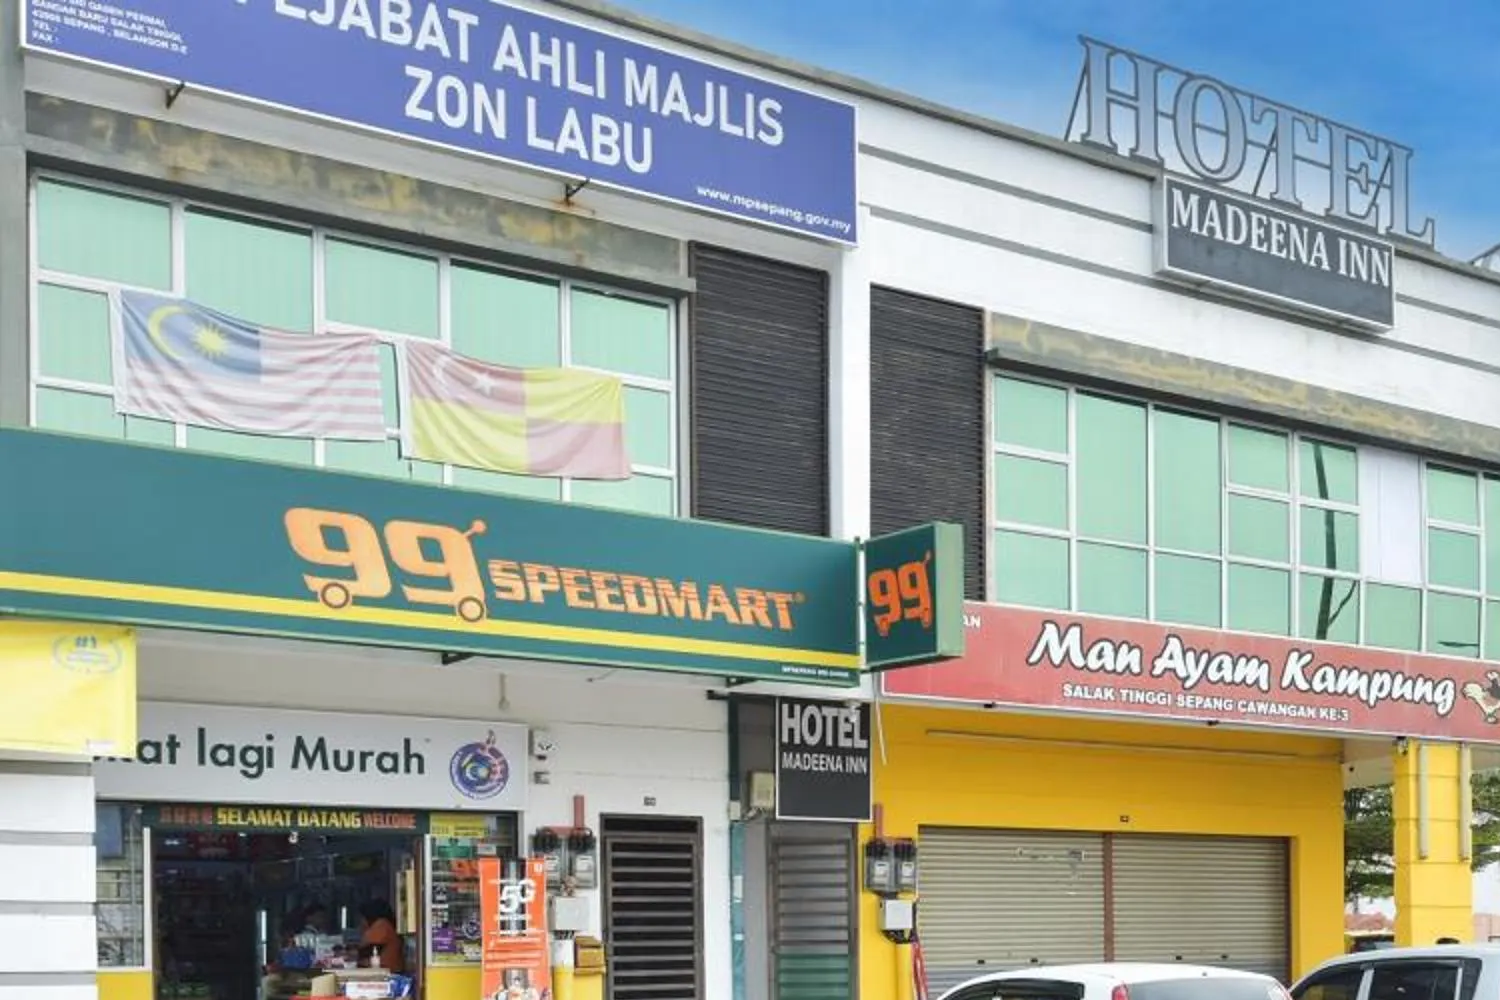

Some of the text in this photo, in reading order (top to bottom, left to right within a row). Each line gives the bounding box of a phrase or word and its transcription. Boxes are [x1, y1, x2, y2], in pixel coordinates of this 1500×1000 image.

[404, 65, 653, 173] ZON LABU
[492, 24, 606, 99] AHLI
[623, 57, 784, 147] MAJLIS
[1078, 33, 1435, 251] HOTEL
[697, 184, 852, 235] www.mpsepang.gov.my
[1171, 186, 1390, 287] MADEENA INN
[283, 506, 796, 631] 99 SPEEDMART
[867, 549, 932, 637] 99
[1027, 620, 1456, 716] Man Ayam Kampung
[1063, 683, 1115, 701] SALAK
[1119, 689, 1172, 706] TINGGI
[1177, 693, 1233, 712] SEPANG
[1237, 700, 1316, 720] CAWANGAN
[197, 727, 274, 779] lagi
[291, 735, 425, 775] Murah
[781, 703, 869, 749] HOTEL
[781, 751, 868, 775] MADEENA INN
[217, 808, 293, 826] SELAMAT
[297, 810, 361, 829] DATANG
[499, 879, 536, 913] 5G
